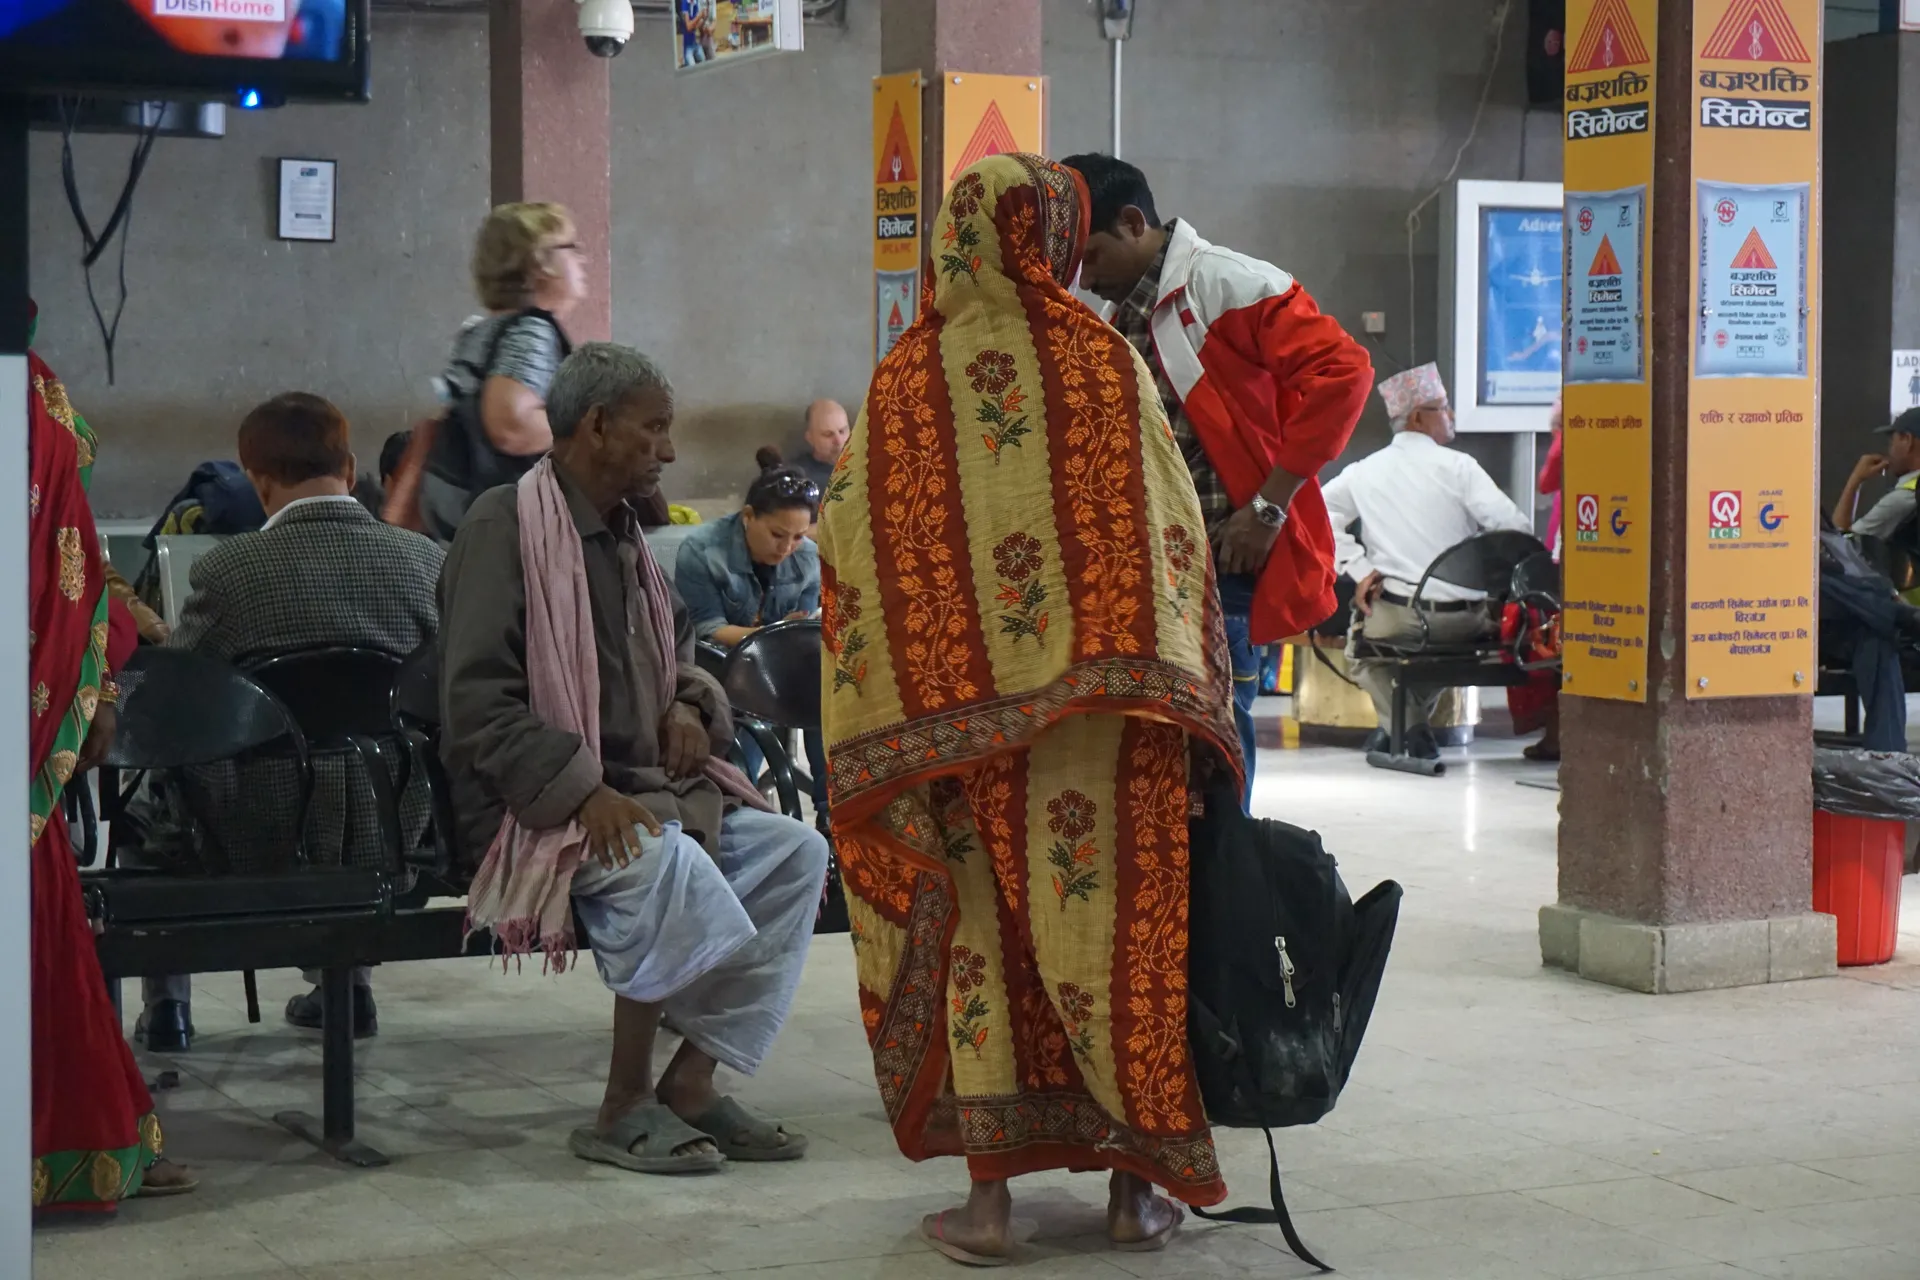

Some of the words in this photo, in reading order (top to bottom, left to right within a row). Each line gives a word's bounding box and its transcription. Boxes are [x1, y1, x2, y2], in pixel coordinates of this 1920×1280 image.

[1567, 107, 1648, 139] सिमेन्ट
[1701, 98, 1810, 129] सिमेन्ट
[879, 217, 915, 237] सिमेन्ट
[1896, 355, 1920, 367] LAD
